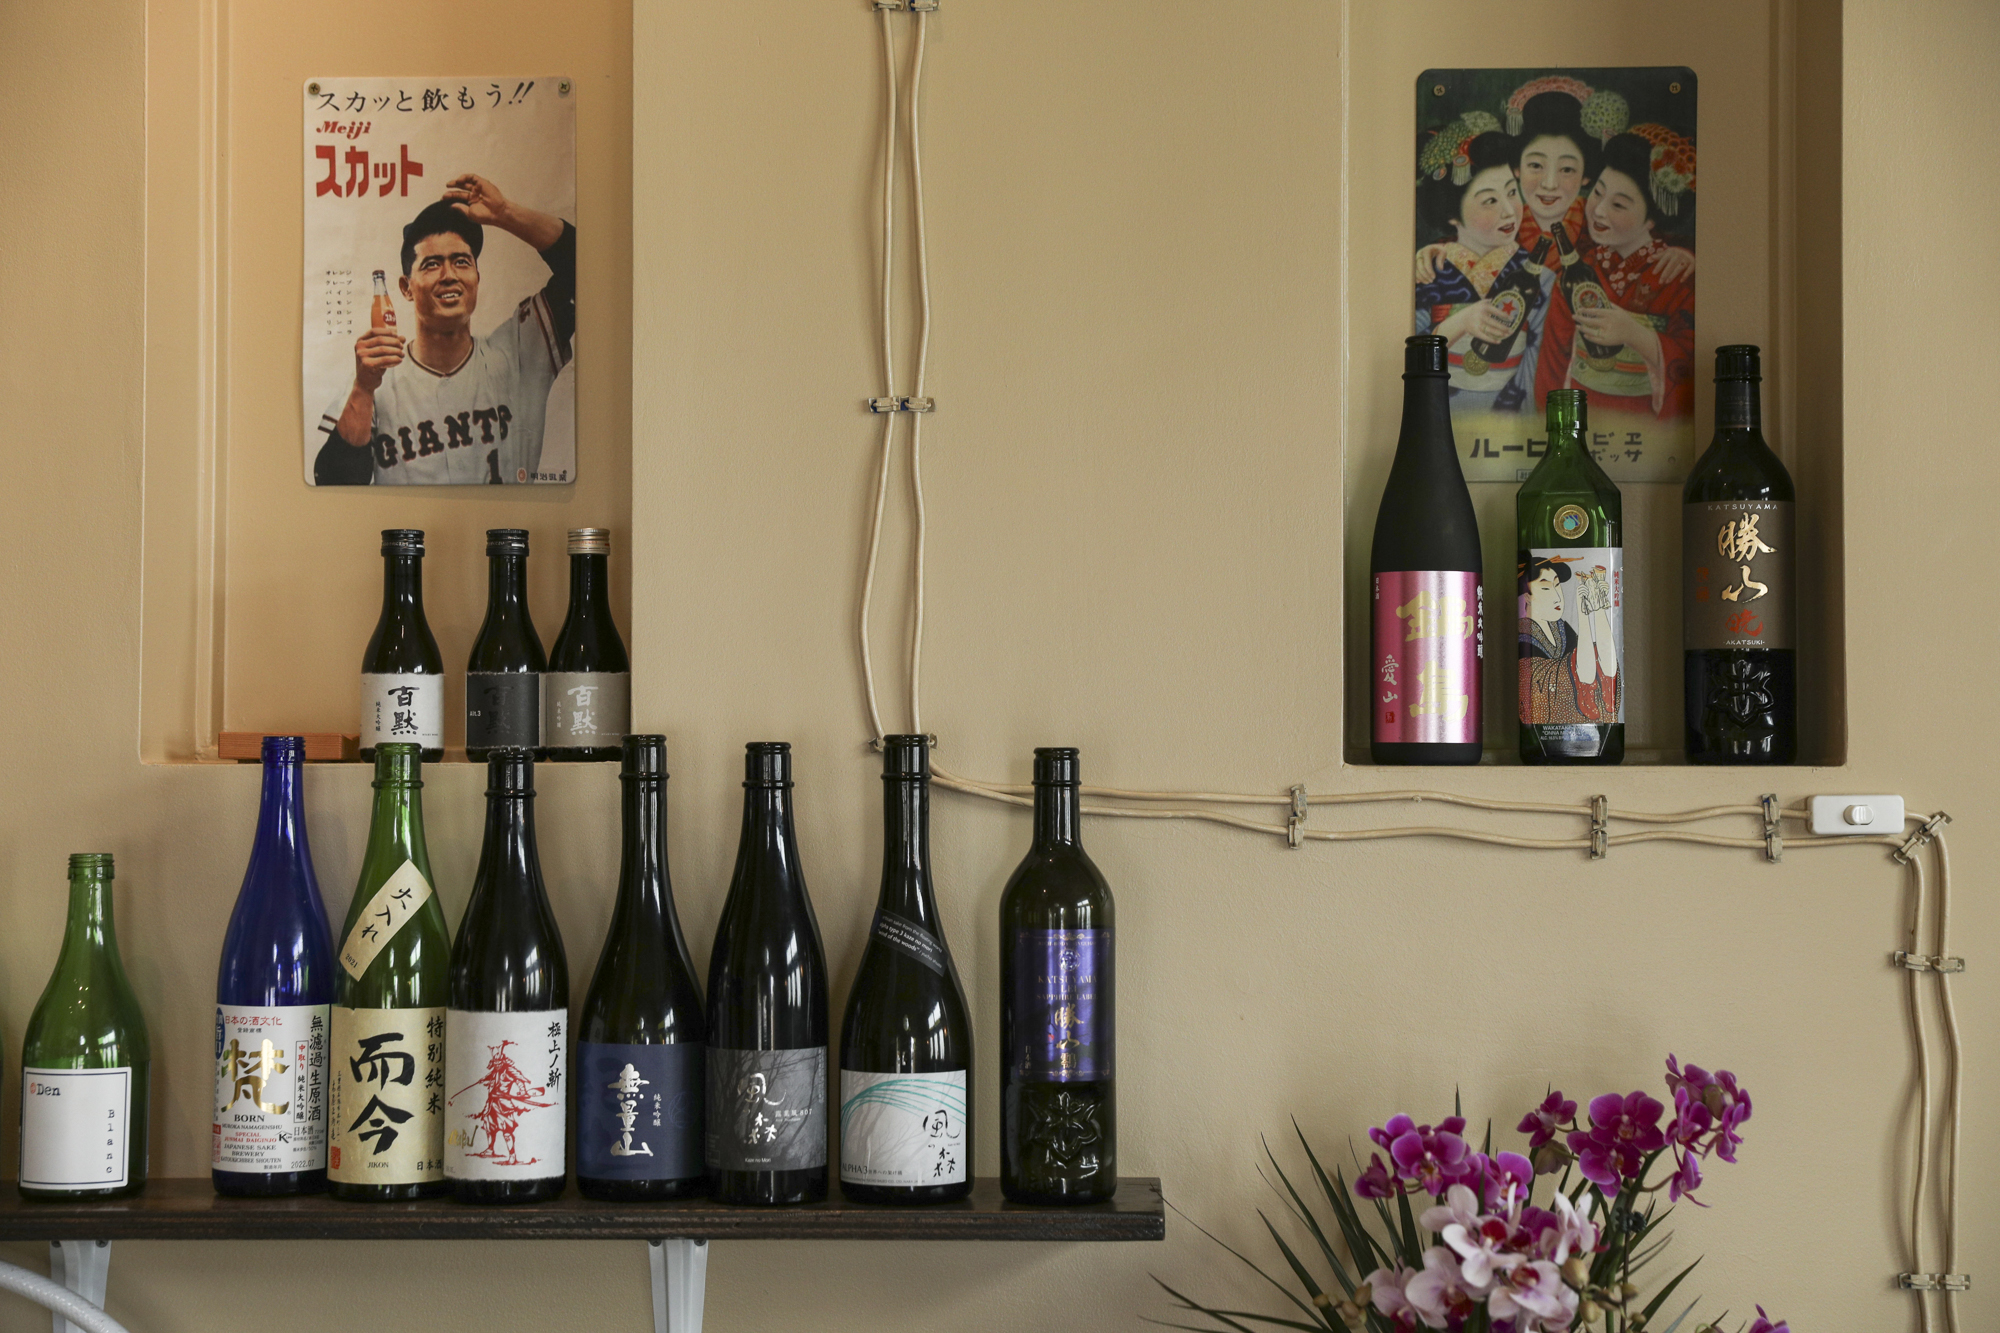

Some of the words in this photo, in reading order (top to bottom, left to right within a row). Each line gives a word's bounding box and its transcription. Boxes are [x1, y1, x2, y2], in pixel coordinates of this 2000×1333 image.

[316, 121, 371, 140] Meiji
[315, 144, 423, 198] スカット
[374, 404, 513, 469] GIANTS
[1707, 503, 1778, 511] KATSUYAMA
[1717, 512, 1777, 604] 勝山
[1725, 608, 1764, 637] 暁
[1382, 654, 1399, 703] 愛山
[903, 932, 915, 942] kaze
[1038, 975, 1097, 984] KATSUYAMA
[225, 1015, 283, 1026] 日本の酒文化
[1054, 1002, 1084, 1050] 勝山
[307, 1015, 324, 1122] 無濾過生原酒
[425, 1015, 444, 1115] 特別純米
[36, 1083, 61, 1096] Den
[347, 1032, 415, 1156] 而今
[652, 1093, 662, 1127] 純米吟醸
[234, 1114, 265, 1123] BORN
[293, 1125, 314, 1136] 日本酒
[106, 1109, 115, 1174] Blanc
[223, 1143, 254, 1151] JAPANESE
[290, 1159, 316, 1169] 2022.07
[367, 1161, 389, 1169] JIKON
[416, 1159, 443, 1172] 日本酒
[842, 1162, 862, 1174] ALPHA
